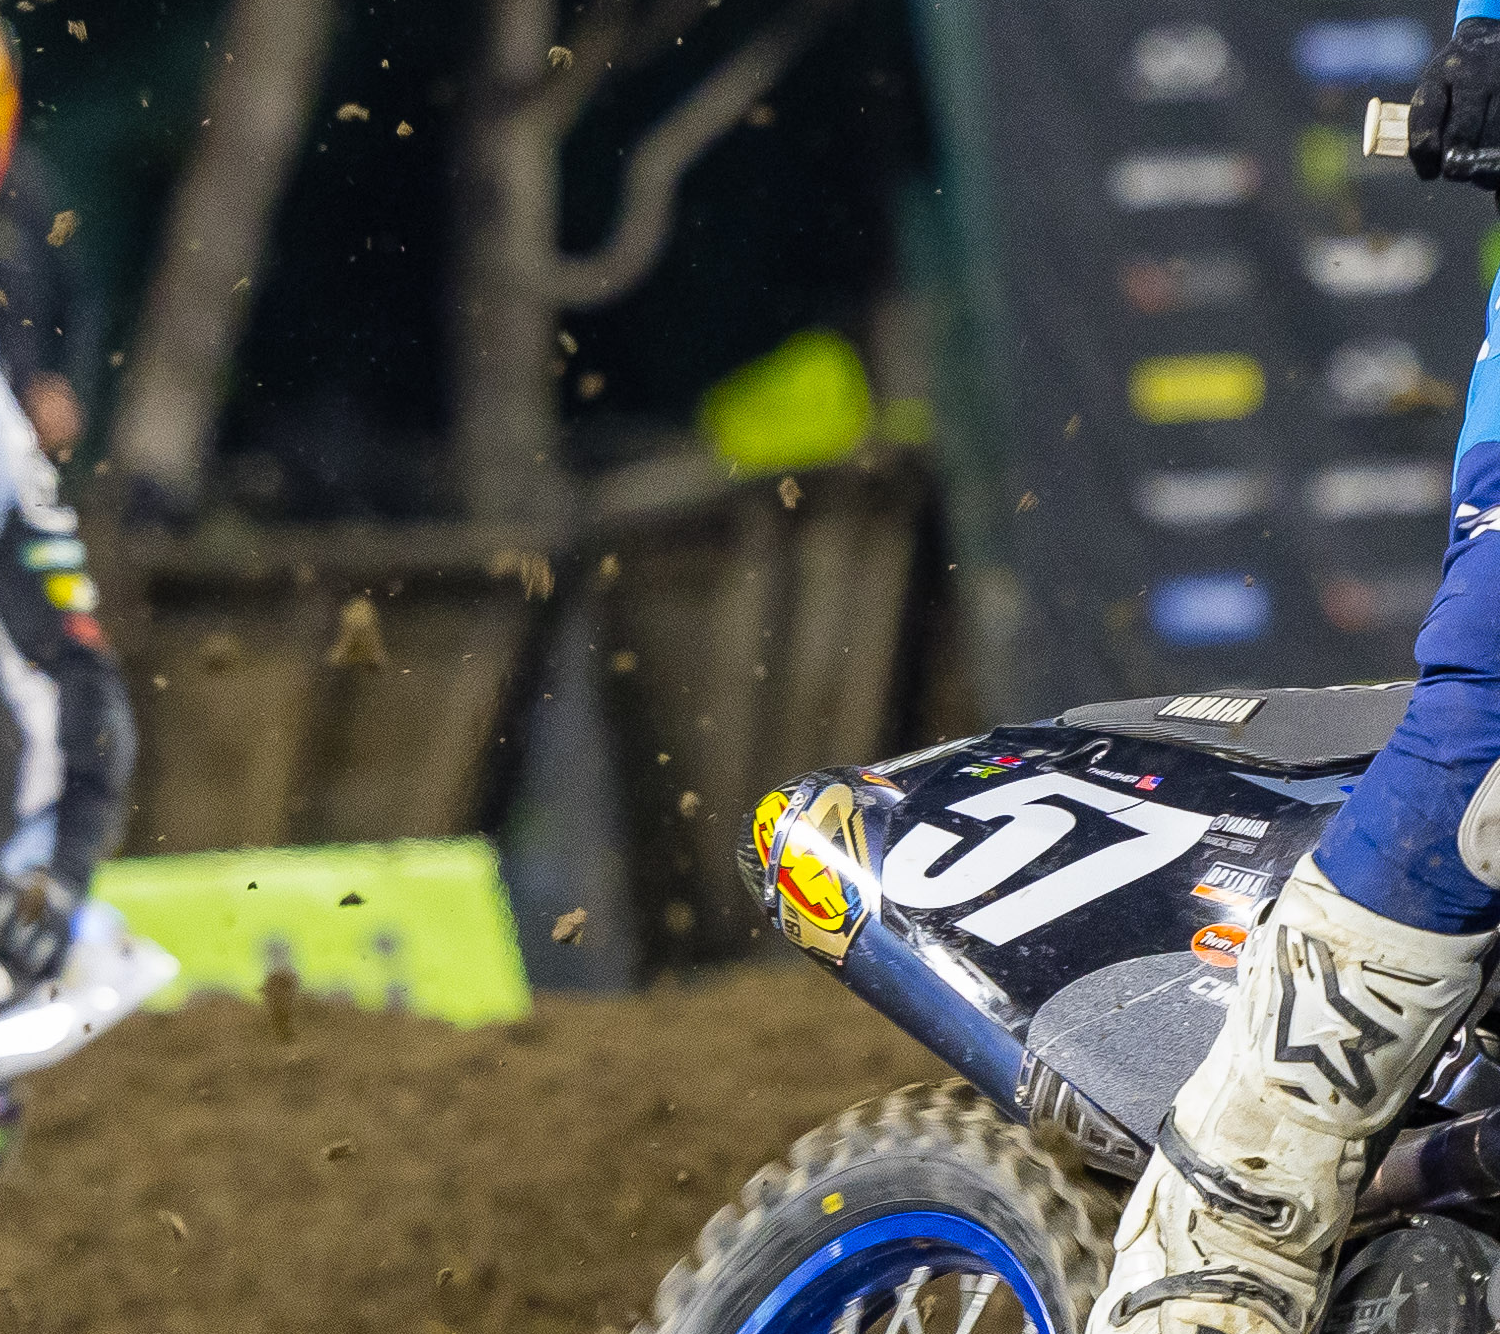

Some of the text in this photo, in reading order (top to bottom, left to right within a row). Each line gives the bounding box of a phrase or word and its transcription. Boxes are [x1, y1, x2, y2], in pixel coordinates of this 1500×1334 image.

[1157, 695, 1262, 724] YAMAHA
[1086, 767, 1141, 785] THRASHER
[1221, 816, 1271, 839] YAMAHA
[882, 771, 1218, 948] 57
[1203, 866, 1266, 898] OPTIMA
[1199, 930, 1235, 954] Twin
